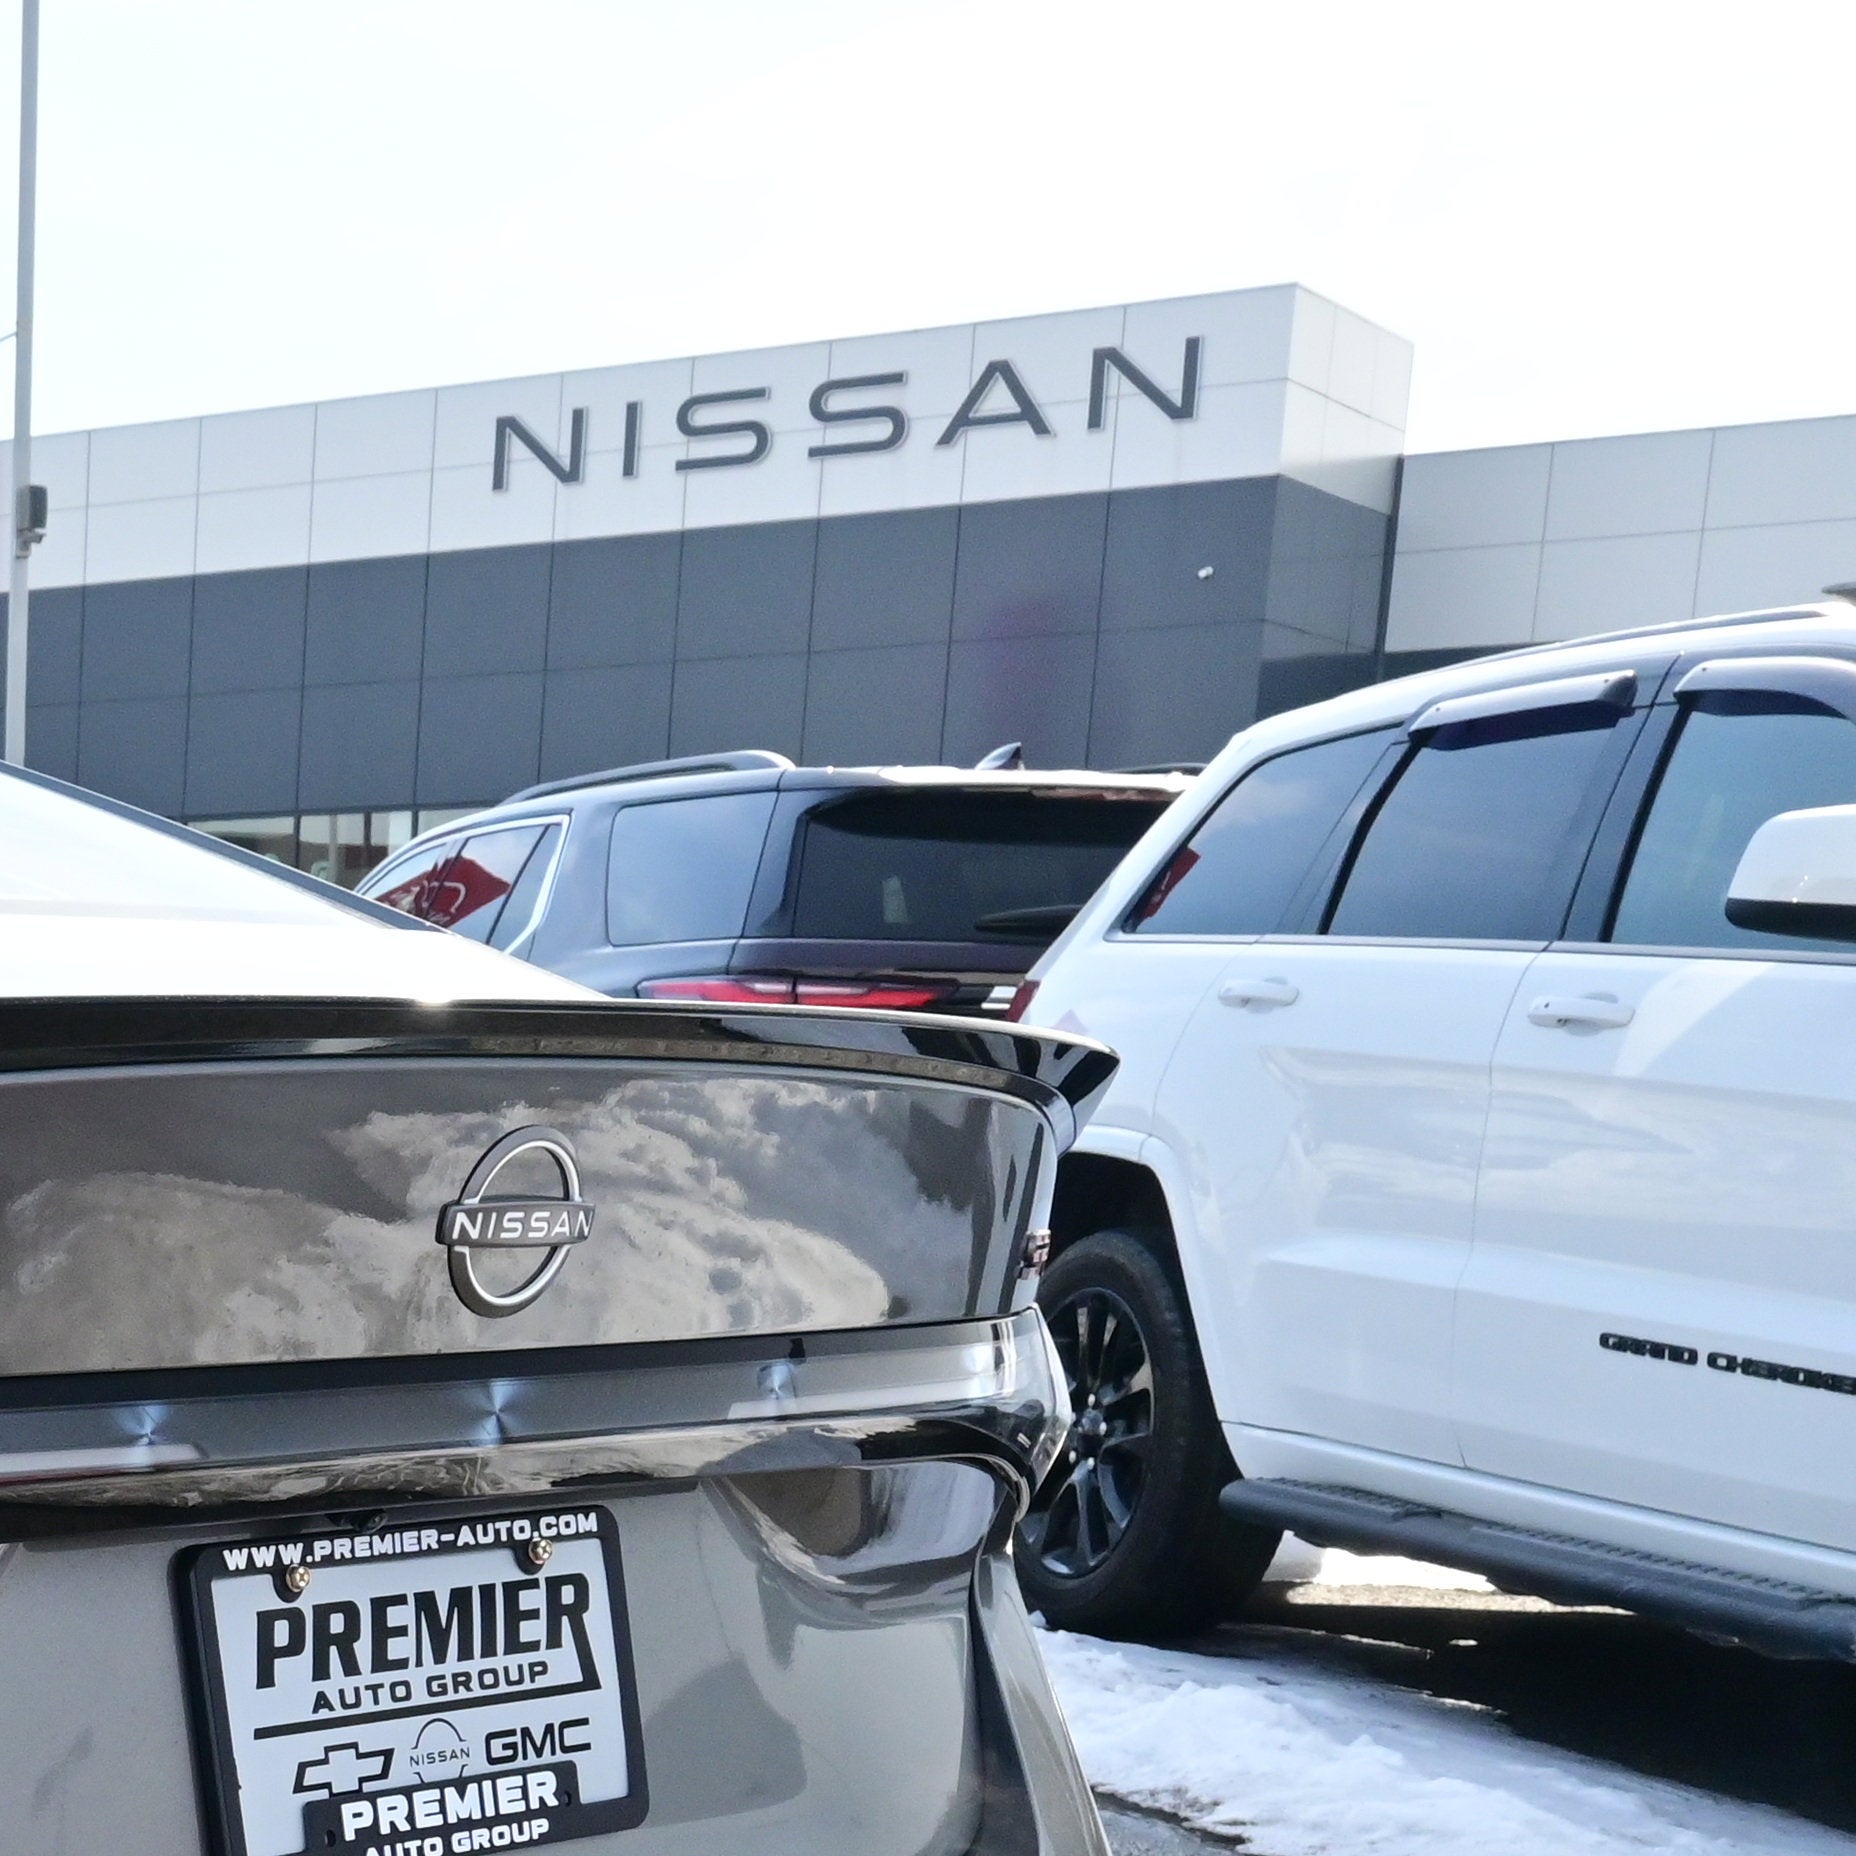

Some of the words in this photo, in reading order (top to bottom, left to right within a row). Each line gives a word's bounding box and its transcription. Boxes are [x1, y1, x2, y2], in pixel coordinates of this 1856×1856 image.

[491, 336, 1203, 492] NISSAN
[452, 1210, 593, 1240] NISSAN
[1599, 1332, 1698, 1365] GRAND
[223, 1513, 598, 1571] WWW.PREMIER-AUTO.COM
[255, 1572, 601, 1690] PREMIER
[312, 1680, 412, 1714] AUTO
[426, 1661, 549, 1697] GROUP
[409, 1747, 470, 1767] NISSAN
[485, 1717, 591, 1766] GMC
[340, 1770, 559, 1842] PREMIER
[451, 1818, 549, 1853] GROUP
